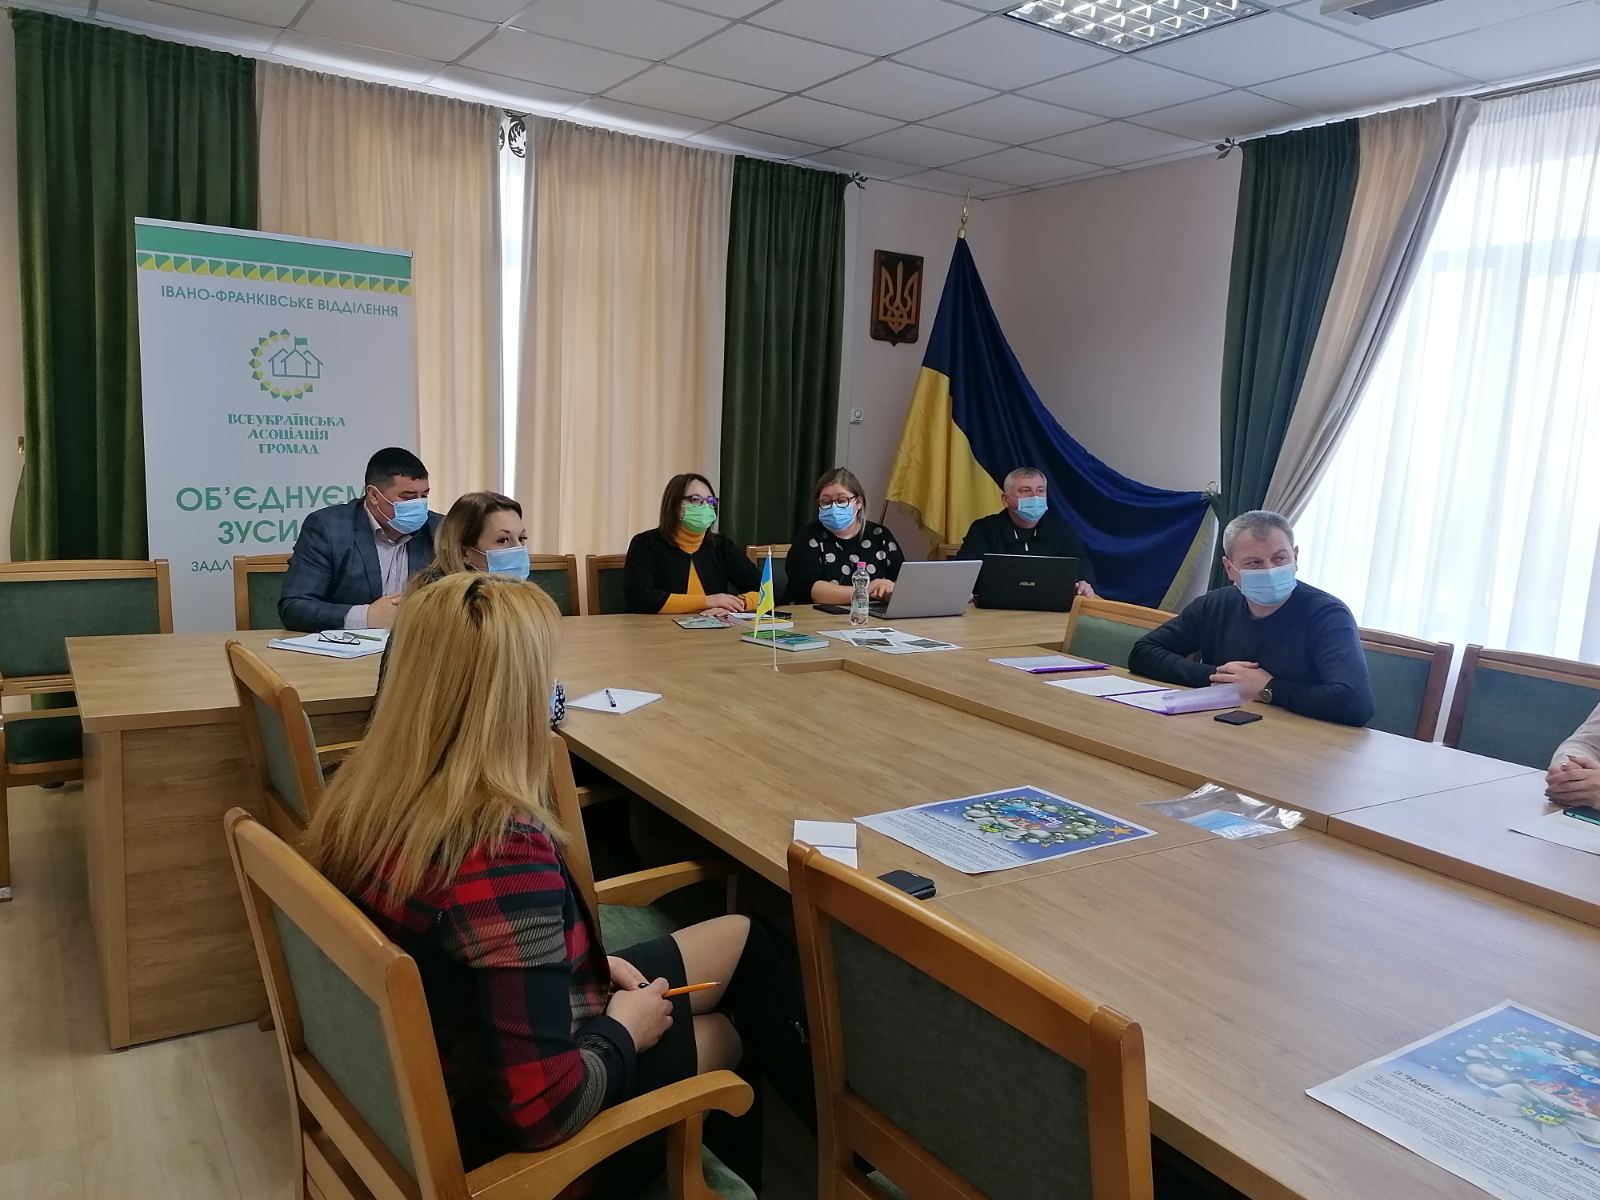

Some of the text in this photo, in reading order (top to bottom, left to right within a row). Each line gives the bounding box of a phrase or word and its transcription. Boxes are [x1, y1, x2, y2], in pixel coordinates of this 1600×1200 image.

[160, 285, 399, 318] ІВАНО-ФРАНКІВСЬКЕ ВІДДІЛЕННЯ
[227, 412, 347, 427] ВСЕУКРАЇНСЬКА
[247, 427, 330, 441] АСОЦІАЦІЯ
[258, 443, 320, 455] ГРОМАД
